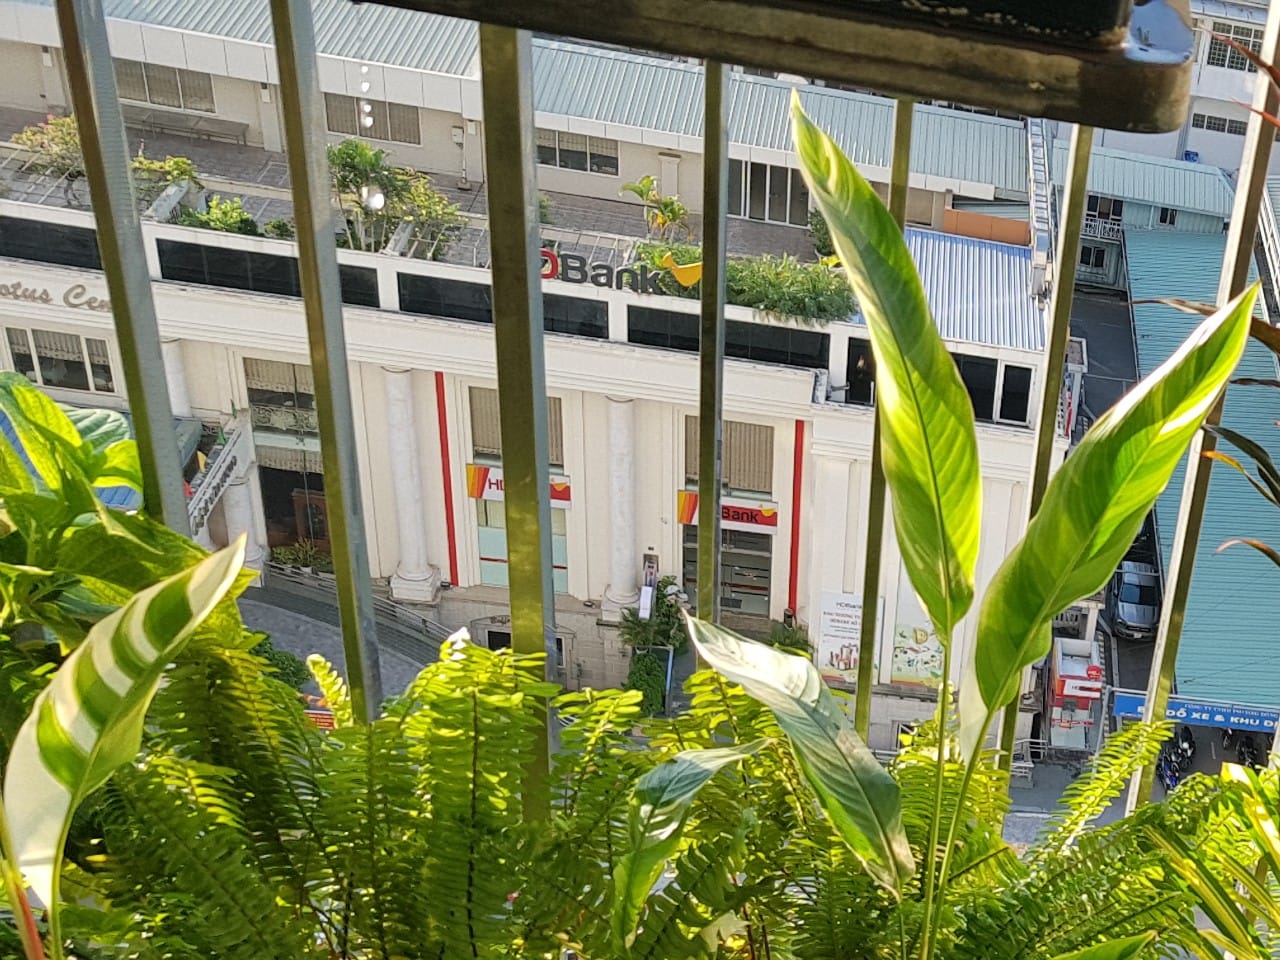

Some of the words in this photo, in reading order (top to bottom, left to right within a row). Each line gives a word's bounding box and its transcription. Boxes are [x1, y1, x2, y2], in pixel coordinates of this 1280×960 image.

[541, 248, 664, 295] DBank
[0, 281, 53, 303] otus
[63, 284, 112, 312] Cen
[722, 506, 759, 523] Bank
[1190, 711, 1210, 720] XE
[1230, 716, 1260, 726] KHU
